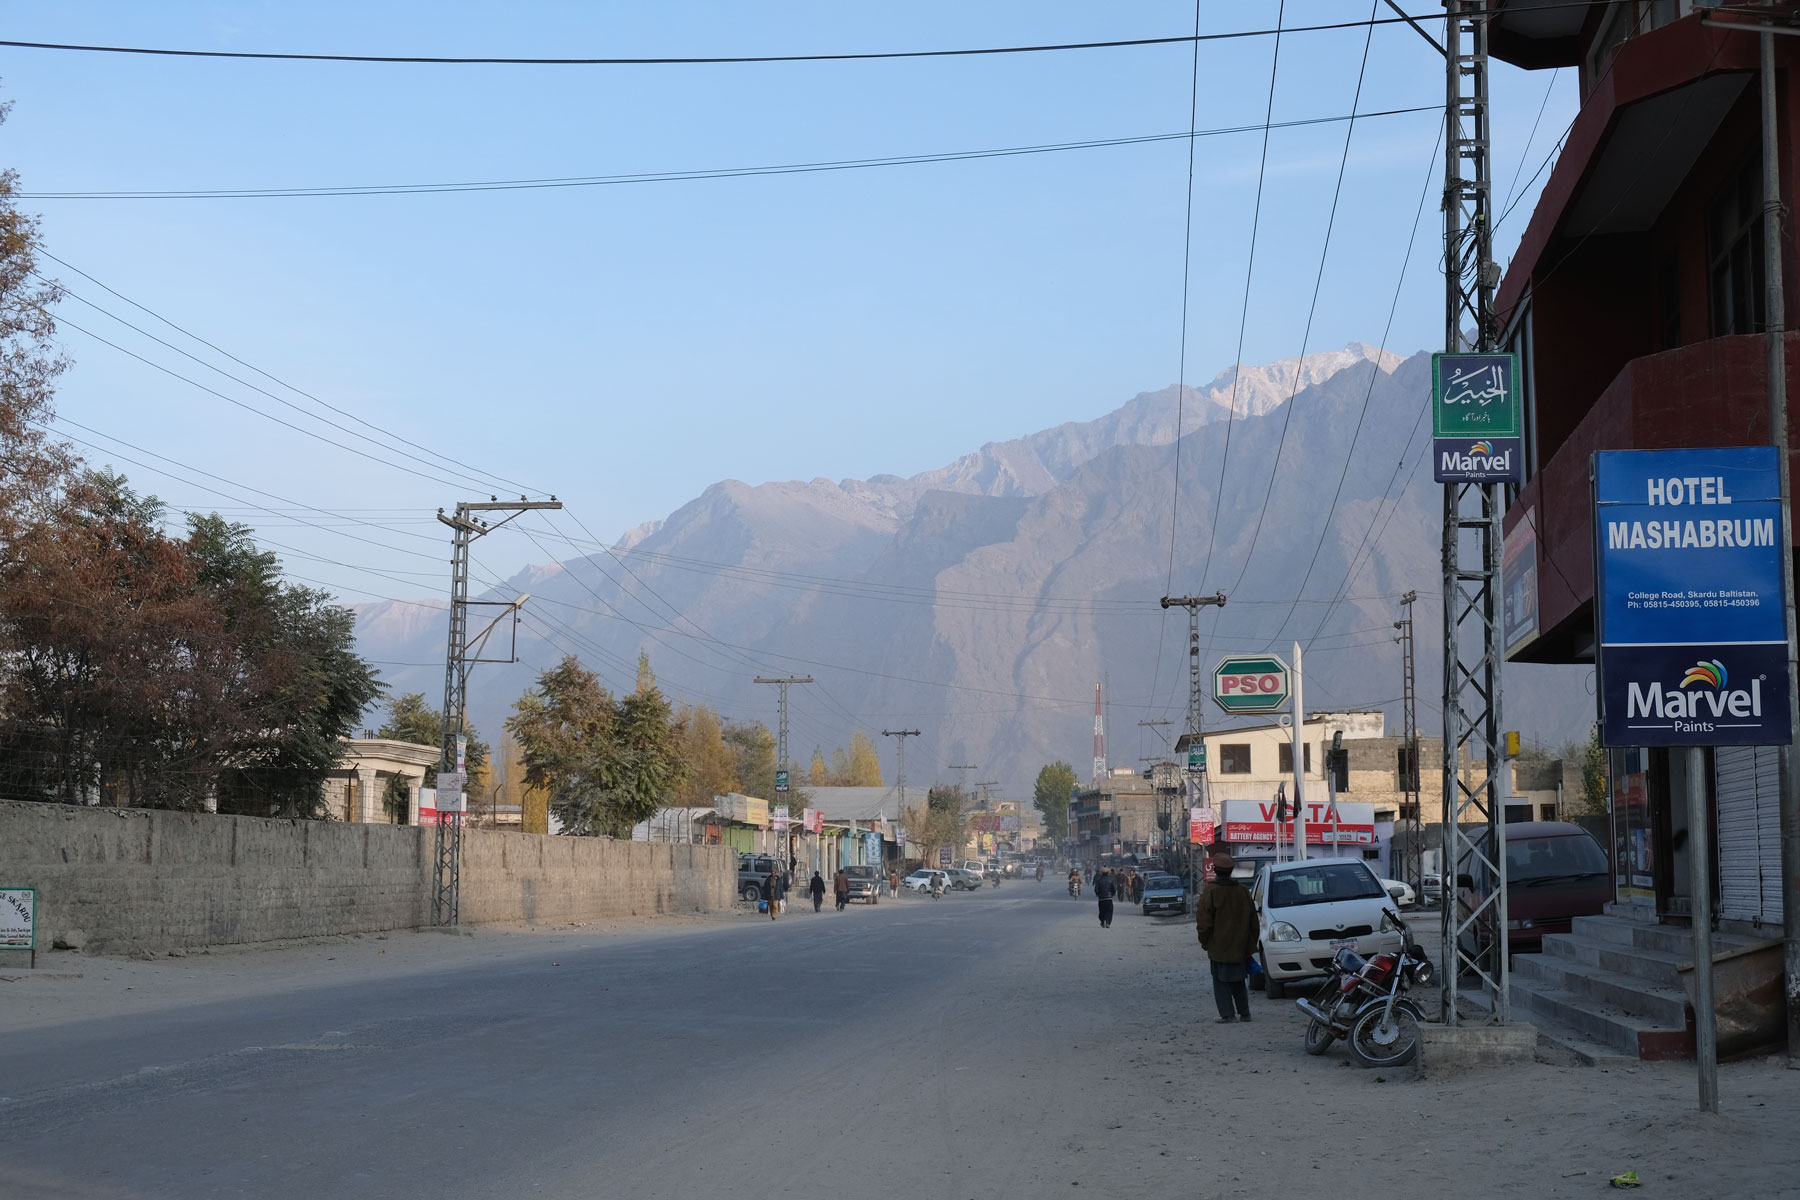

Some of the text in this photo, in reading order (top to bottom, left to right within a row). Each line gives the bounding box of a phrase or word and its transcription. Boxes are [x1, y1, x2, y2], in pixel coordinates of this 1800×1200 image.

[1442, 450, 1510, 471] Marvel
[1647, 476, 1732, 506] HOTEL
[1608, 518, 1775, 550] MASHABRUM
[1627, 599, 1760, 609] Ph: 05815-450395, 05815-450396
[1628, 590, 1759, 600] College Road, Skardu Baltistan.
[1221, 674, 1280, 694] PSO
[1627, 678, 1762, 719] Marvel
[1674, 720, 1714, 732] Paints
[1230, 832, 1253, 840] BATTERY
[1253, 832, 1273, 840] AGENCY
[7, 895, 31, 923] SKARDU
